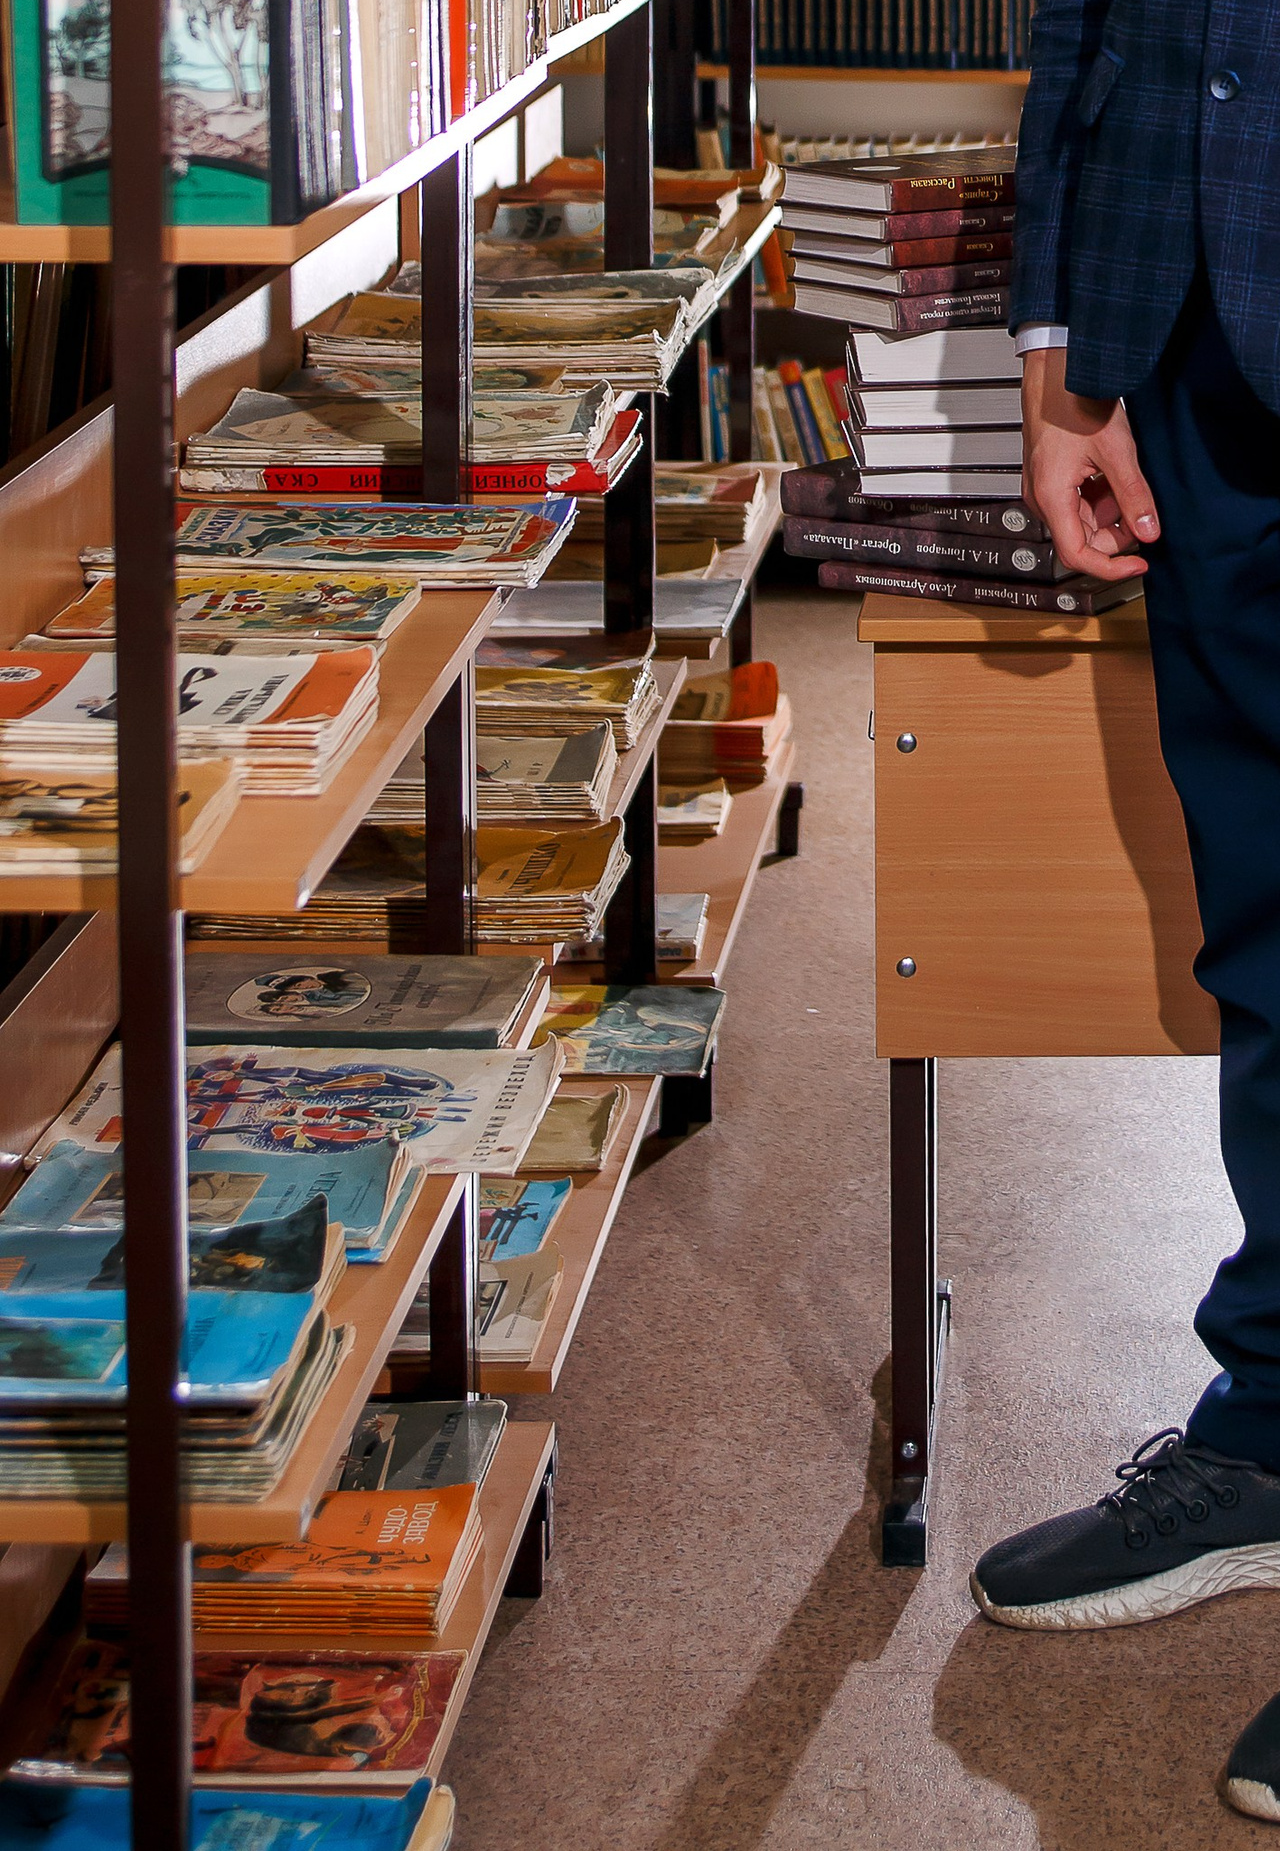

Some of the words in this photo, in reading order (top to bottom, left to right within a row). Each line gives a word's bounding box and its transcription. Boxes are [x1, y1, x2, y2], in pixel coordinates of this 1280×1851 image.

[910, 178, 955, 190] Рассказы
[963, 174, 1003, 186] Повести
[959, 218, 986, 227] Сказки
[966, 242, 994, 252] Сказки
[974, 269, 1000, 278] Сказки
[920, 309, 944, 320] города
[474, 474, 547, 488] ОРНЕЙ
[847, 495, 893, 512] Обломов
[910, 503, 957, 520] Гончаров
[960, 508, 974, 521] А.
[976, 511, 989, 524] И.
[195, 509, 239, 541] СКАЗКИ
[803, 533, 859, 550] «Паллада»
[861, 538, 901, 555] Фрегат
[916, 543, 965, 560] Гончаров
[968, 549, 982, 561] А.
[985, 550, 999, 564] И.
[855, 574, 927, 593] Артамоновых
[929, 582, 957, 597] Дело
[974, 587, 1019, 603] Горький
[1021, 592, 1037, 606] М.
[504, 842, 561, 896] ОЛЧИШКО
[494, 1054, 537, 1110] ВЕЗДЕХОД
[402, 1500, 440, 1545] ЗАВОД
